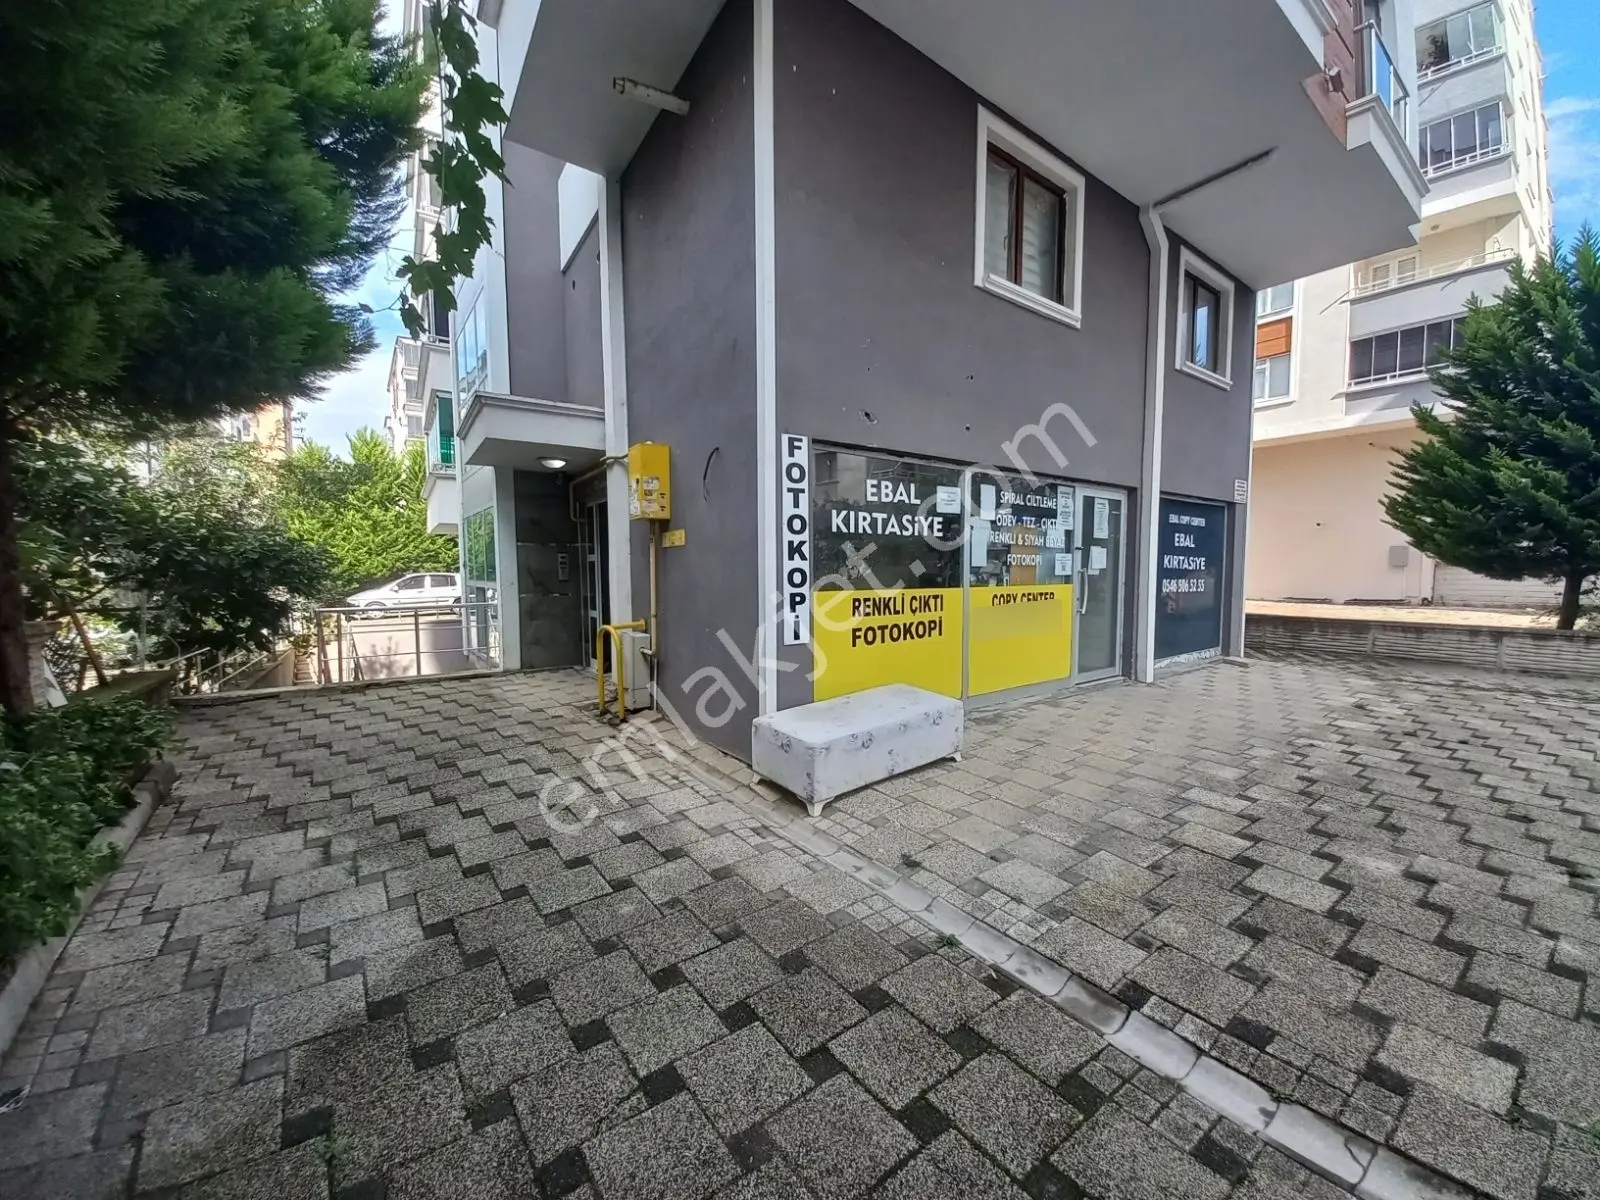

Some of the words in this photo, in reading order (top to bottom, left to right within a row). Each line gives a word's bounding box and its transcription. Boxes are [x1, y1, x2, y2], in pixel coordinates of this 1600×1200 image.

[866, 479, 921, 505] EBAL
[1022, 516, 1036, 528] TEZ
[1017, 533, 1023, 545] &
[1174, 533, 1196, 547] EBAL
[1189, 578, 1197, 592] 52
[1197, 578, 1205, 592] 55
[852, 593, 905, 617] RENKLİ
[910, 594, 944, 616] ÇIKTI
[851, 616, 943, 647] FOTOKOPİ
